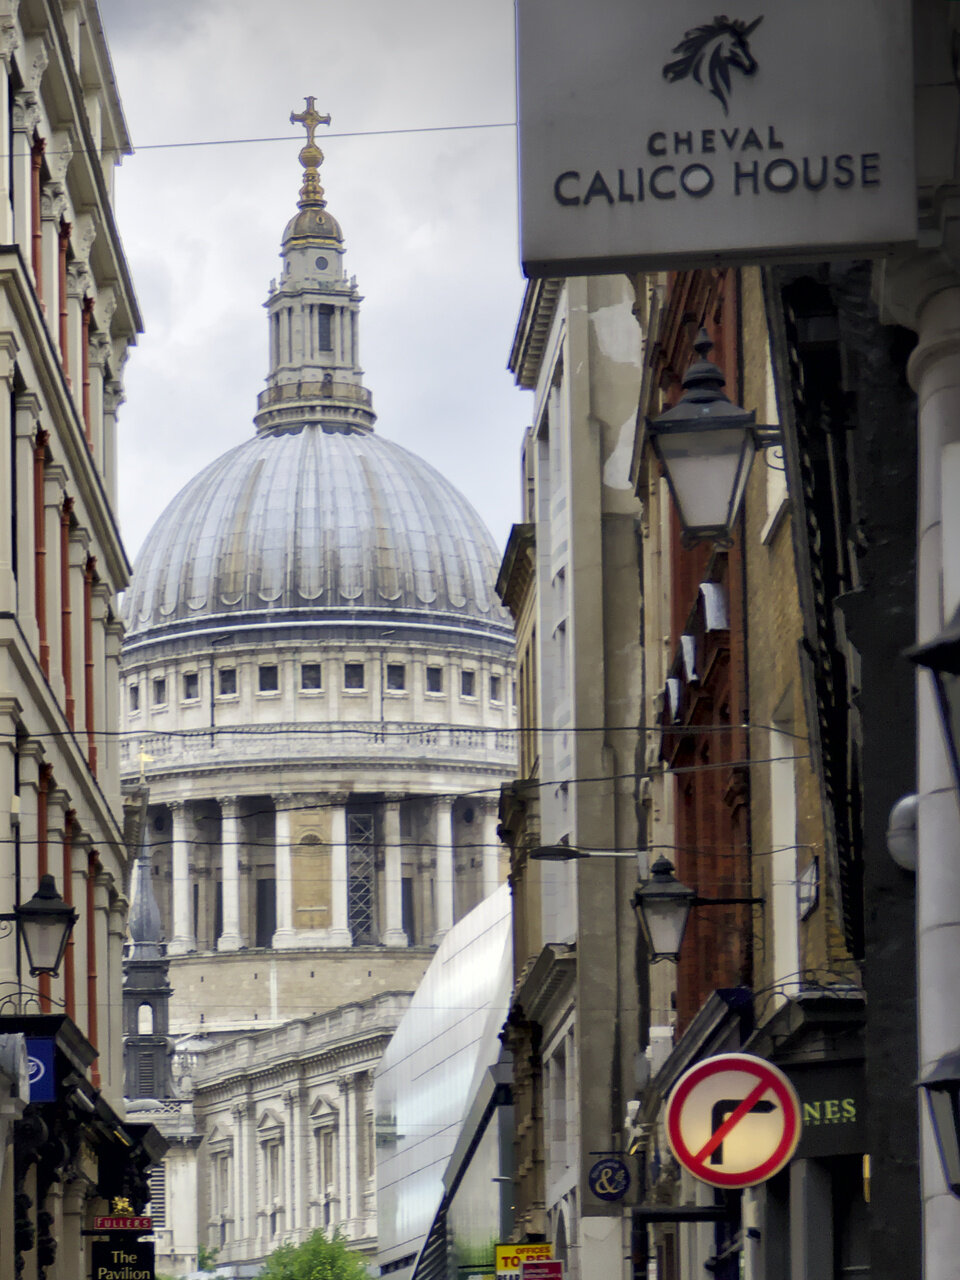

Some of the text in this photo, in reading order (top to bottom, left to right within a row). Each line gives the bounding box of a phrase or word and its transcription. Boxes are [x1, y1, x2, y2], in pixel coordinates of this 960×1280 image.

[647, 126, 784, 156] CHEVAL
[553, 153, 881, 206] CALICO HOUSE
[803, 1098, 857, 1120] NES
[111, 1250, 138, 1264] The
[515, 1246, 551, 1254] OFFICES
[501, 1255, 521, 1267] TO
[98, 1267, 150, 1280] Pavilion
